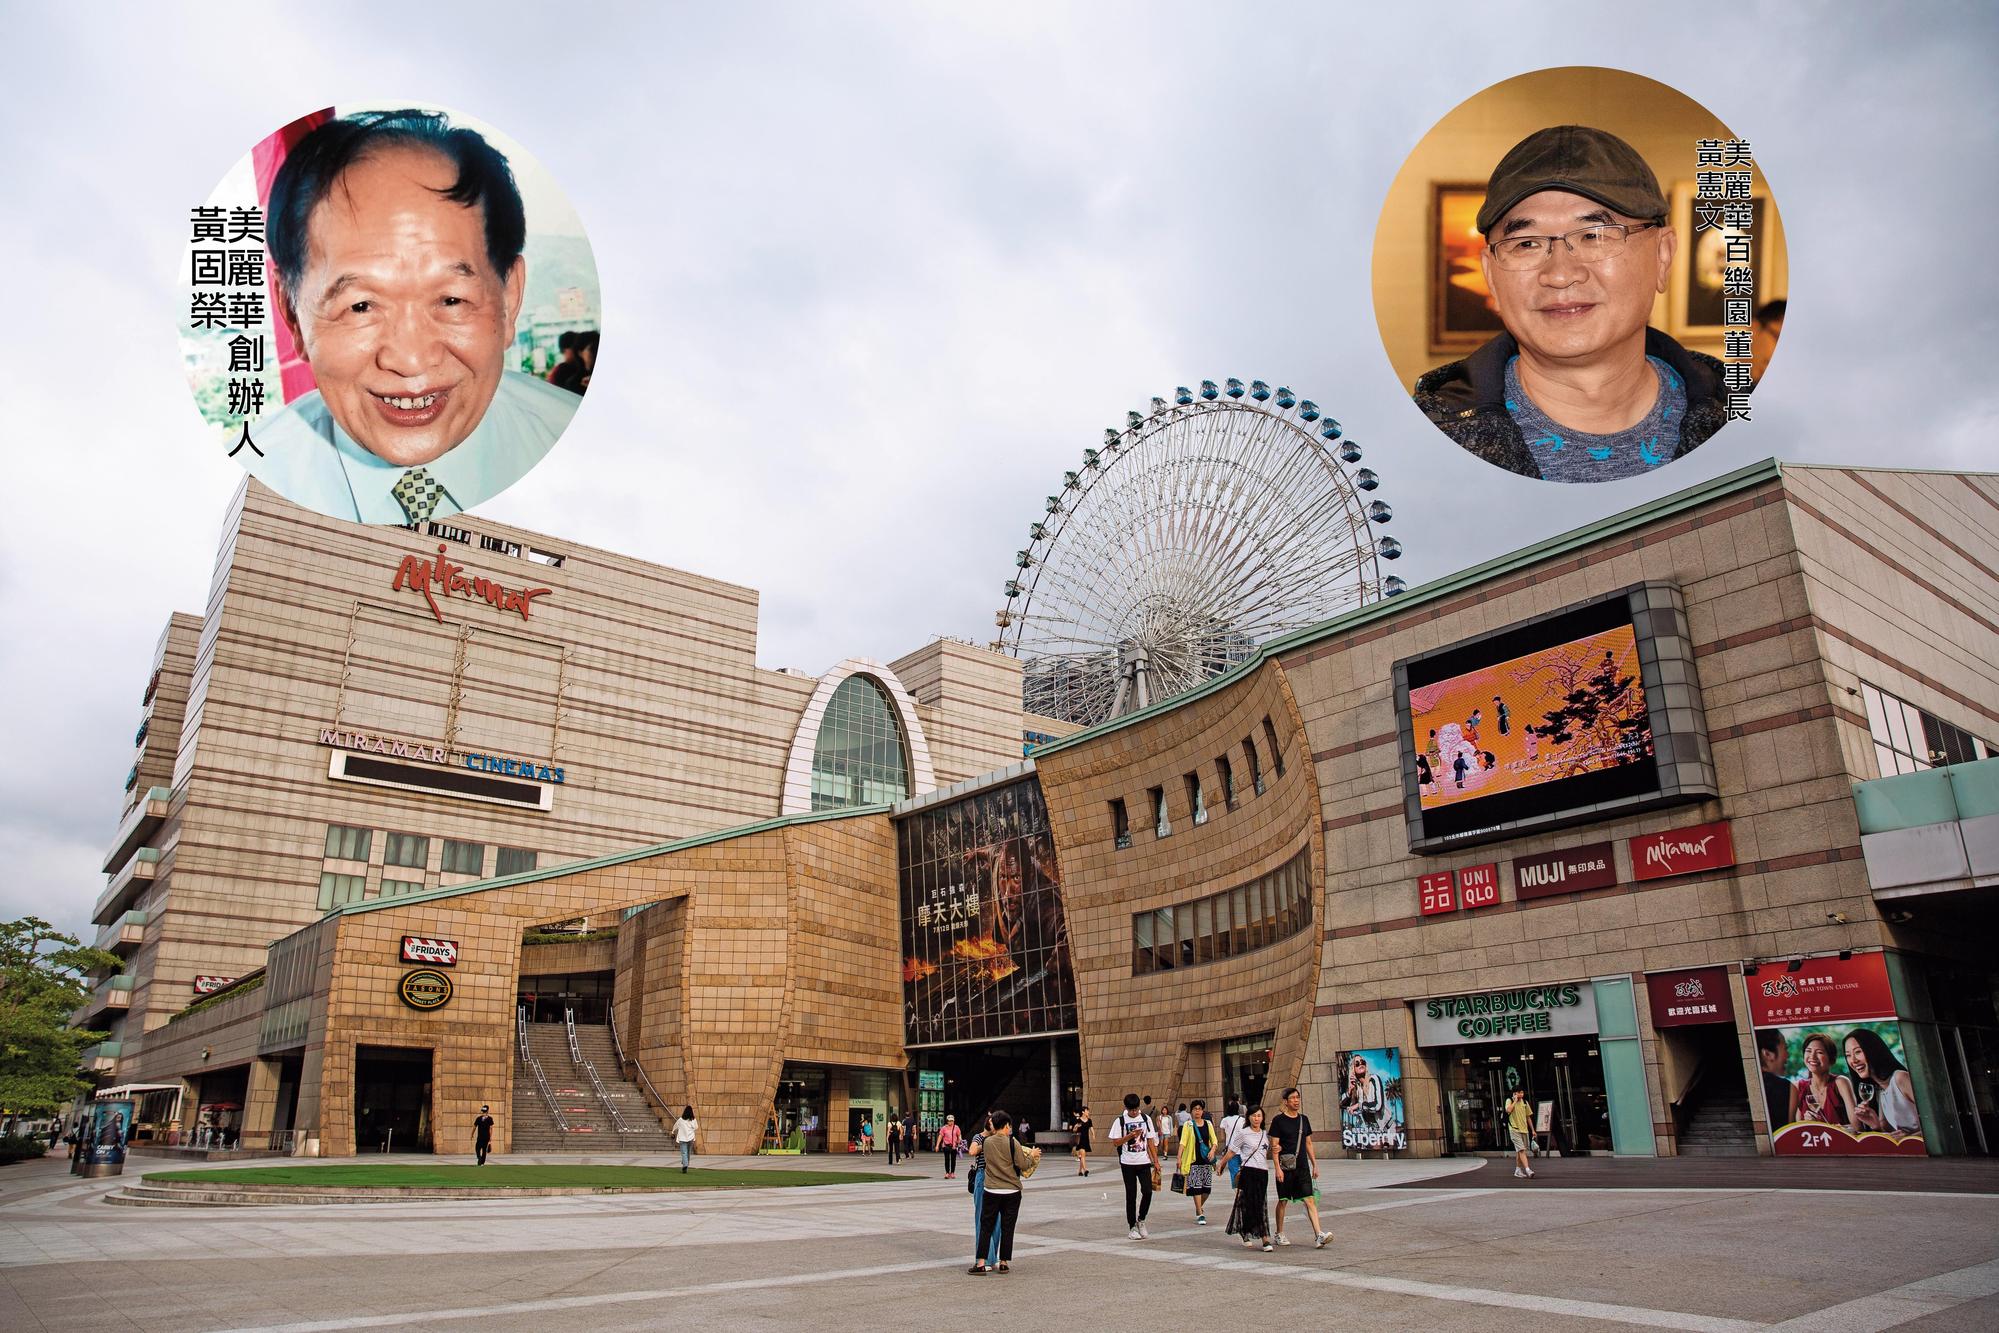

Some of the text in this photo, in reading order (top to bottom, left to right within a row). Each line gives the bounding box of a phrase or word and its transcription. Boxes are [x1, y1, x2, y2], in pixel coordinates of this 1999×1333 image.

[393, 543, 553, 624] Miramar
[318, 729, 565, 783] MIRAMAR CINEMAS
[1646, 835, 1715, 872] Miramar
[1464, 869, 1489, 887] UNI
[1520, 859, 1606, 887] MUJI 無印良品
[918, 886, 980, 927] 摩天大樓
[1466, 886, 1494, 905] QLO
[415, 945, 450, 956] FRIDAYS
[1761, 975, 1799, 997] 瓦城
[1816, 984, 1834, 992] TOWN
[1427, 985, 1579, 1019] STARBUCKS
[1457, 1011, 1552, 1038] COFFEE
[1801, 1131, 1820, 1147] 2F
